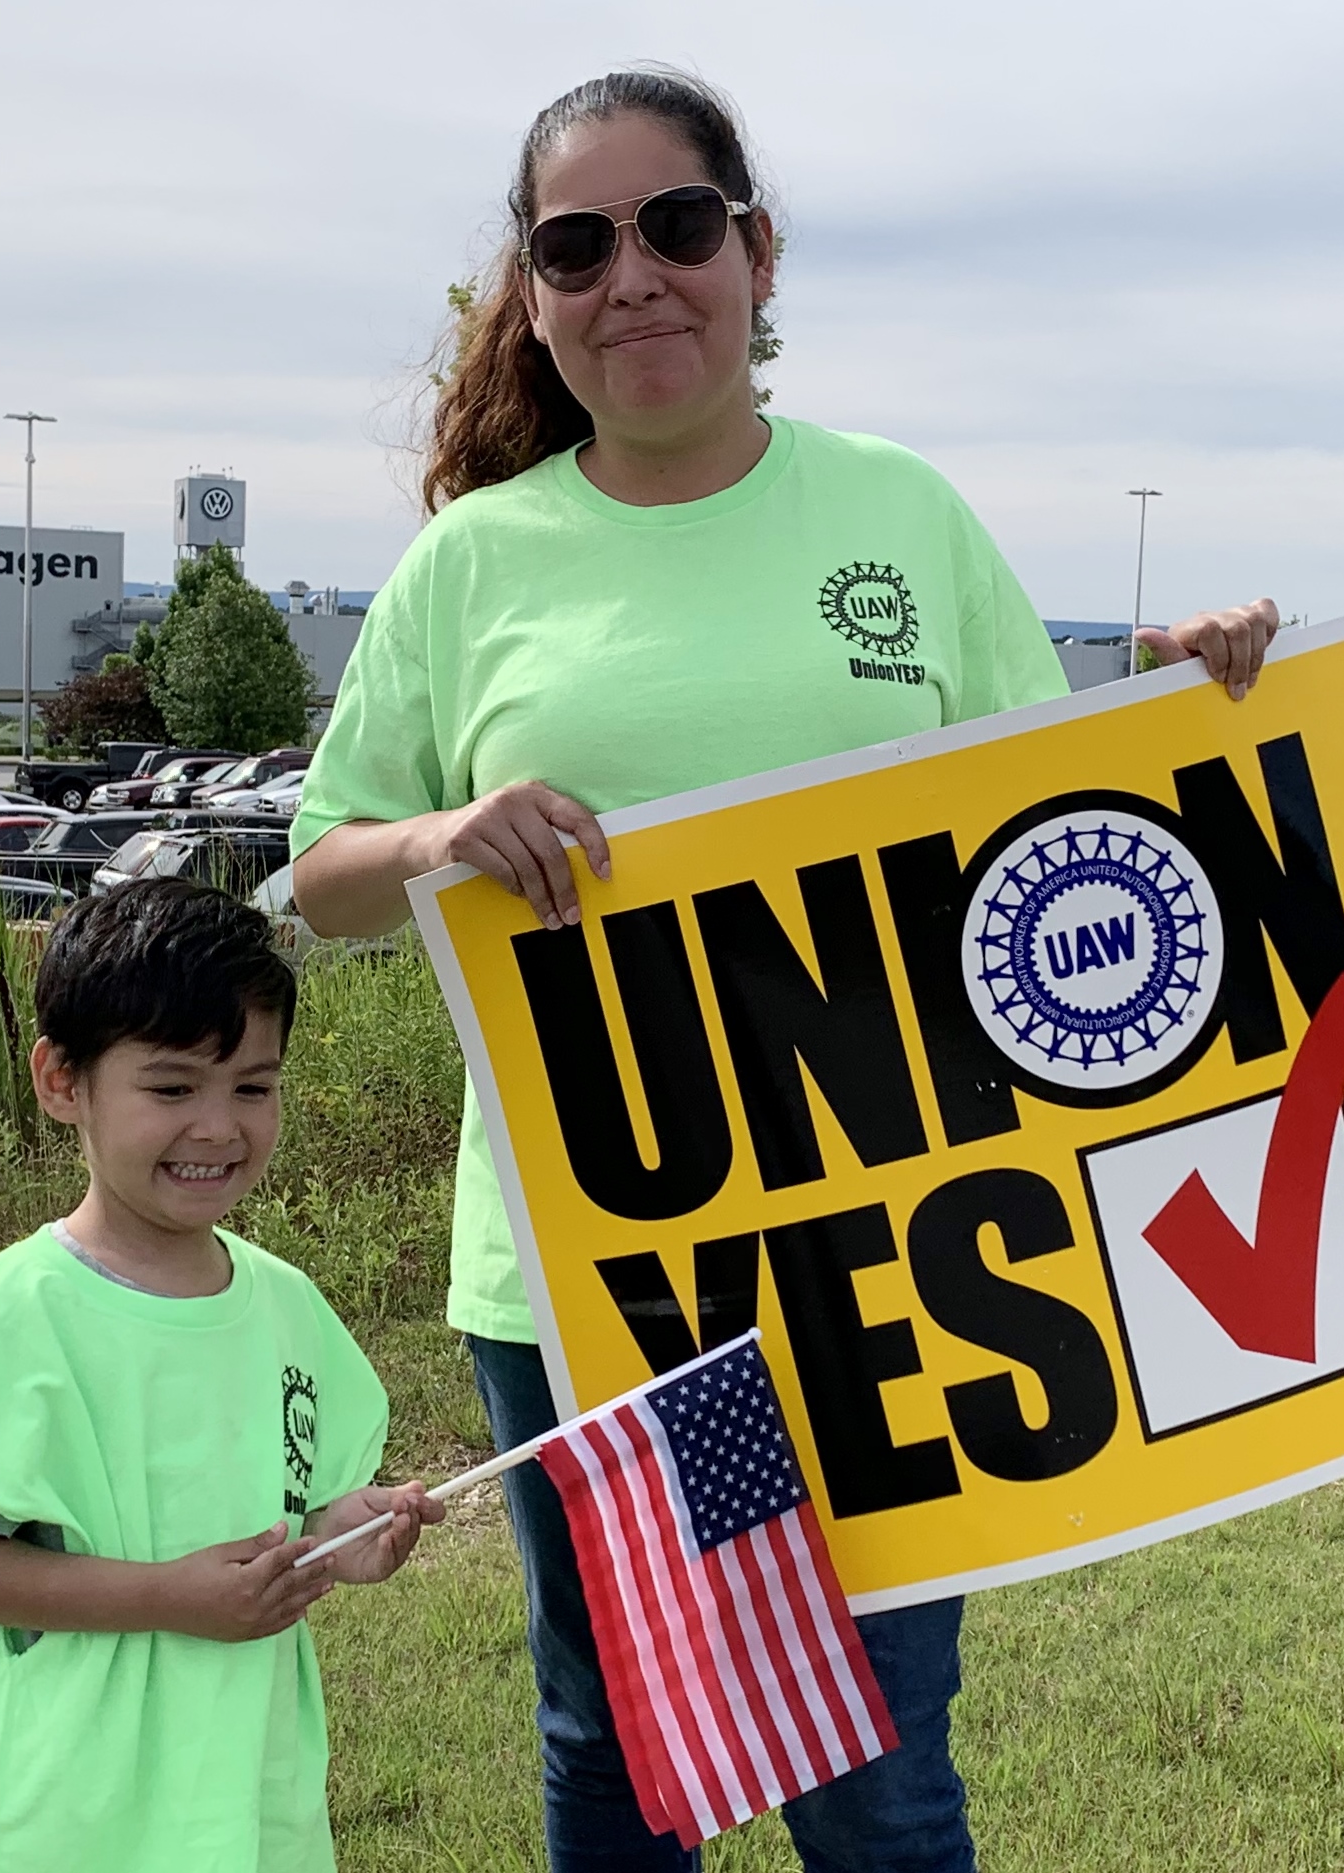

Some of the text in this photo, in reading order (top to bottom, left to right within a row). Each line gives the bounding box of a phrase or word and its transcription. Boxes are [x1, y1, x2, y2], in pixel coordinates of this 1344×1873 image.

[850, 595, 898, 622] UAW
[1014, 865, 1171, 1030] UNITED AUTOMOBILE, AEROSPACE AND AGRICULTURAL IMPLEMENT WORKERS OF AMERICA
[1044, 912, 1135, 980] UAW
